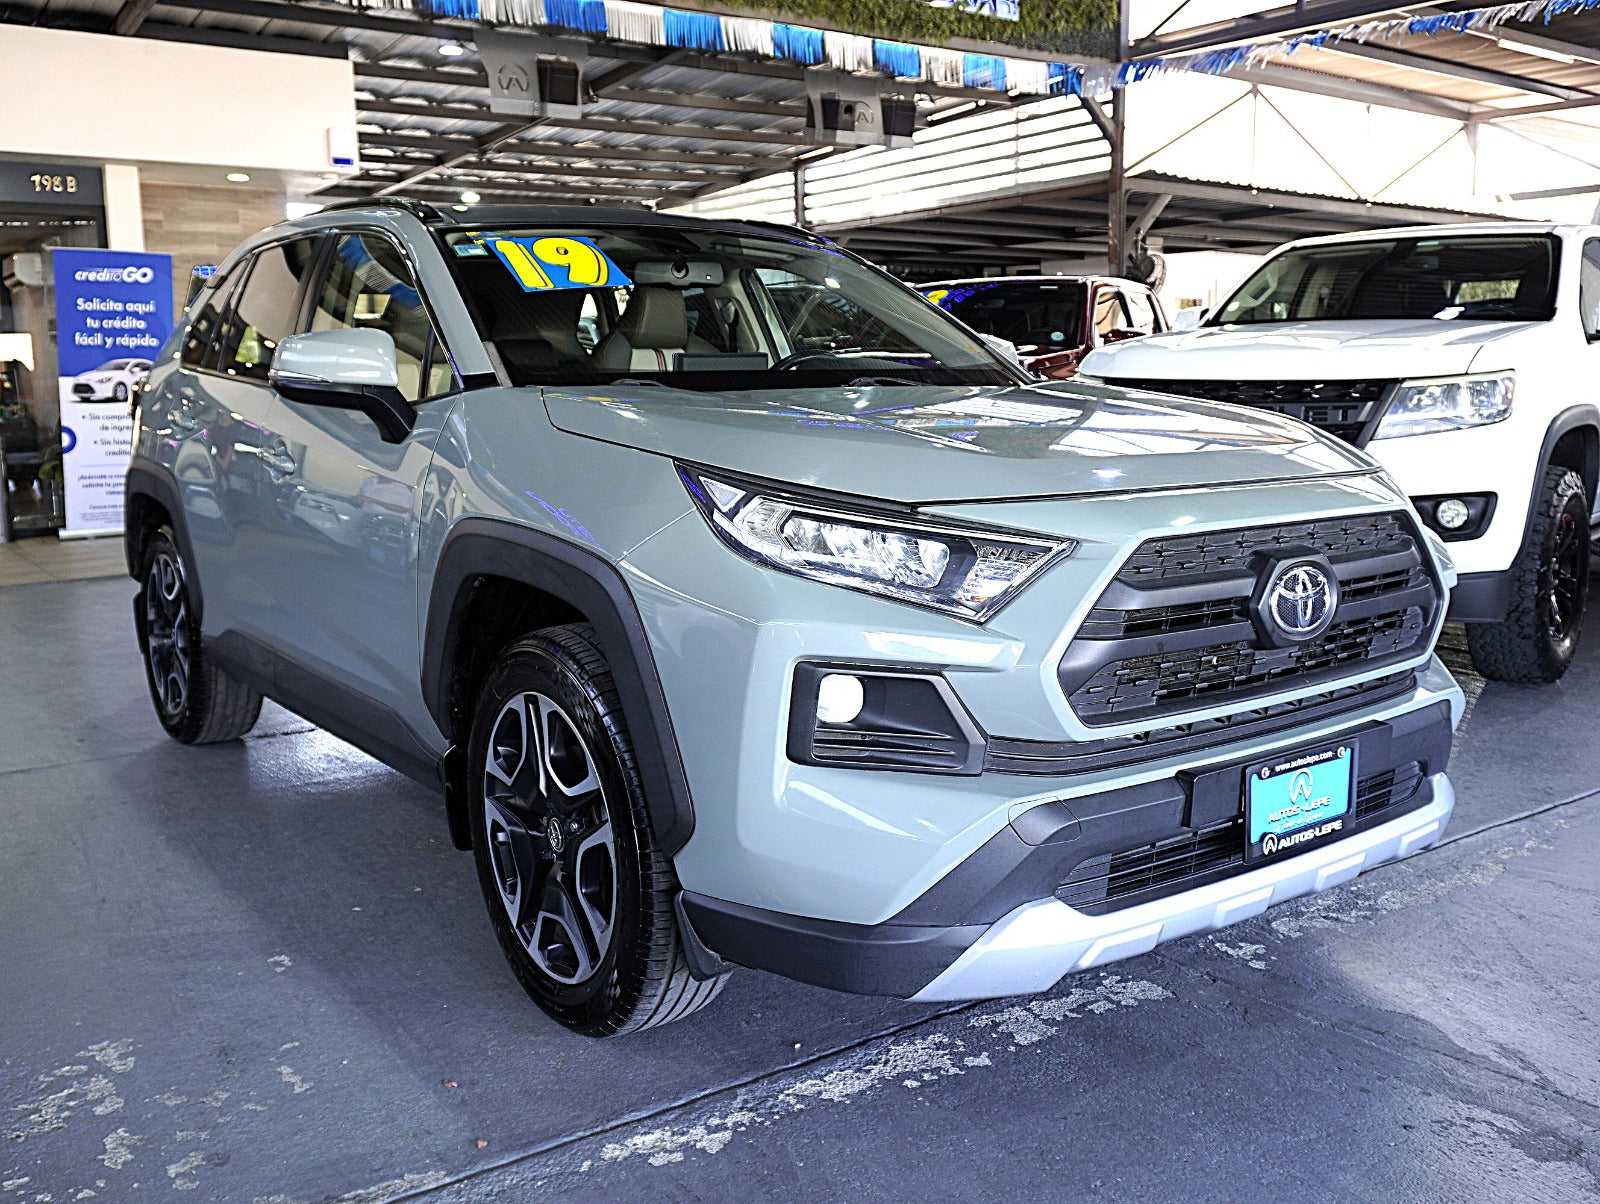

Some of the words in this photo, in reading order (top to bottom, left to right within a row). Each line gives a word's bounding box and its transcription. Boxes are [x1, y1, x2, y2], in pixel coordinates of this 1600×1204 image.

[495, 237, 609, 289] 19
[76, 297, 124, 312] Solicita
[125, 300, 156, 315] aquí
[86, 316, 100, 329] tu
[102, 315, 147, 330] crédito
[74, 331, 103, 346] fácil
[104, 336, 114, 349] y
[115, 332, 160, 349] rápido
